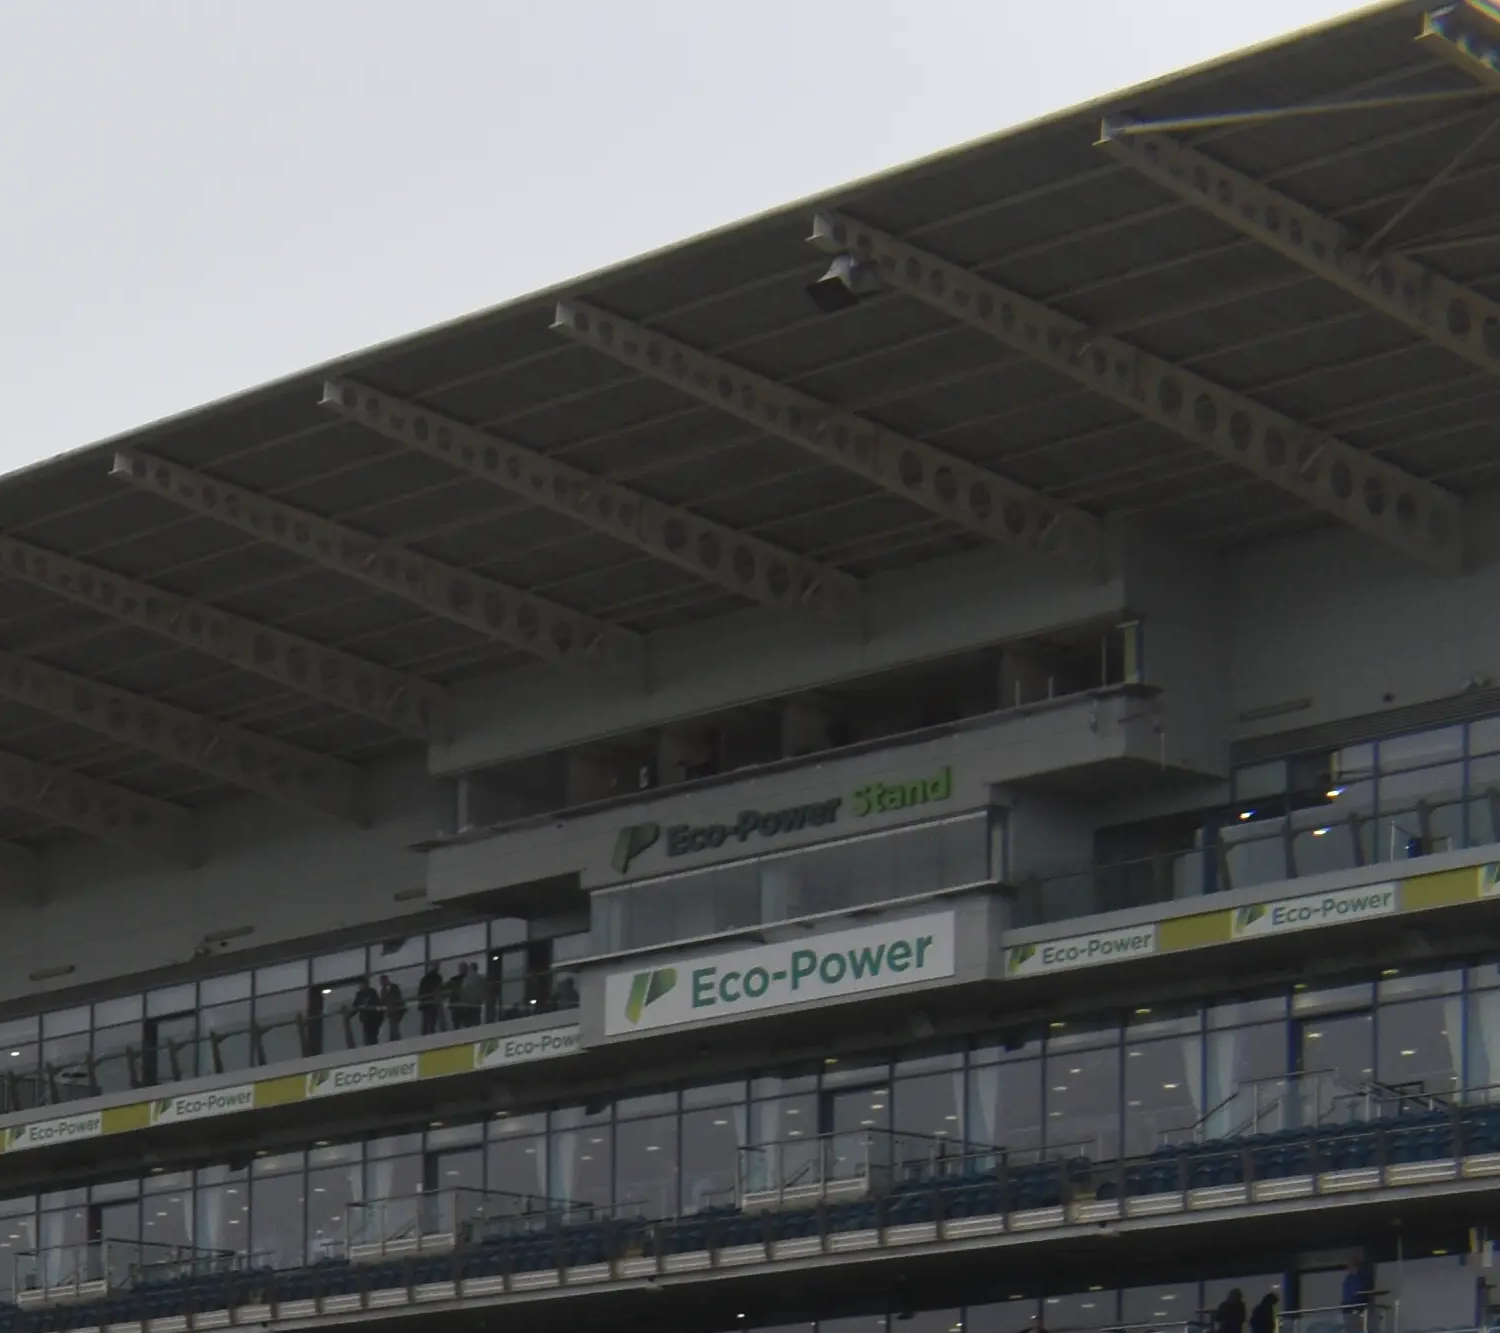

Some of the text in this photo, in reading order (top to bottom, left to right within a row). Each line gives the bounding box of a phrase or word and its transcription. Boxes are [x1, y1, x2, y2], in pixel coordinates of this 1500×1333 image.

[666, 765, 954, 858] Eco-Power Stand
[1271, 889, 1392, 926] Eco-Power
[1042, 933, 1152, 965] Eco-Power
[691, 934, 934, 1009] Eco-Power
[504, 1034, 580, 1058] Eco-Pow
[334, 1060, 417, 1088] Eco-Power
[176, 1090, 253, 1116] Eco-Power
[29, 1118, 101, 1142] Eco-Power
